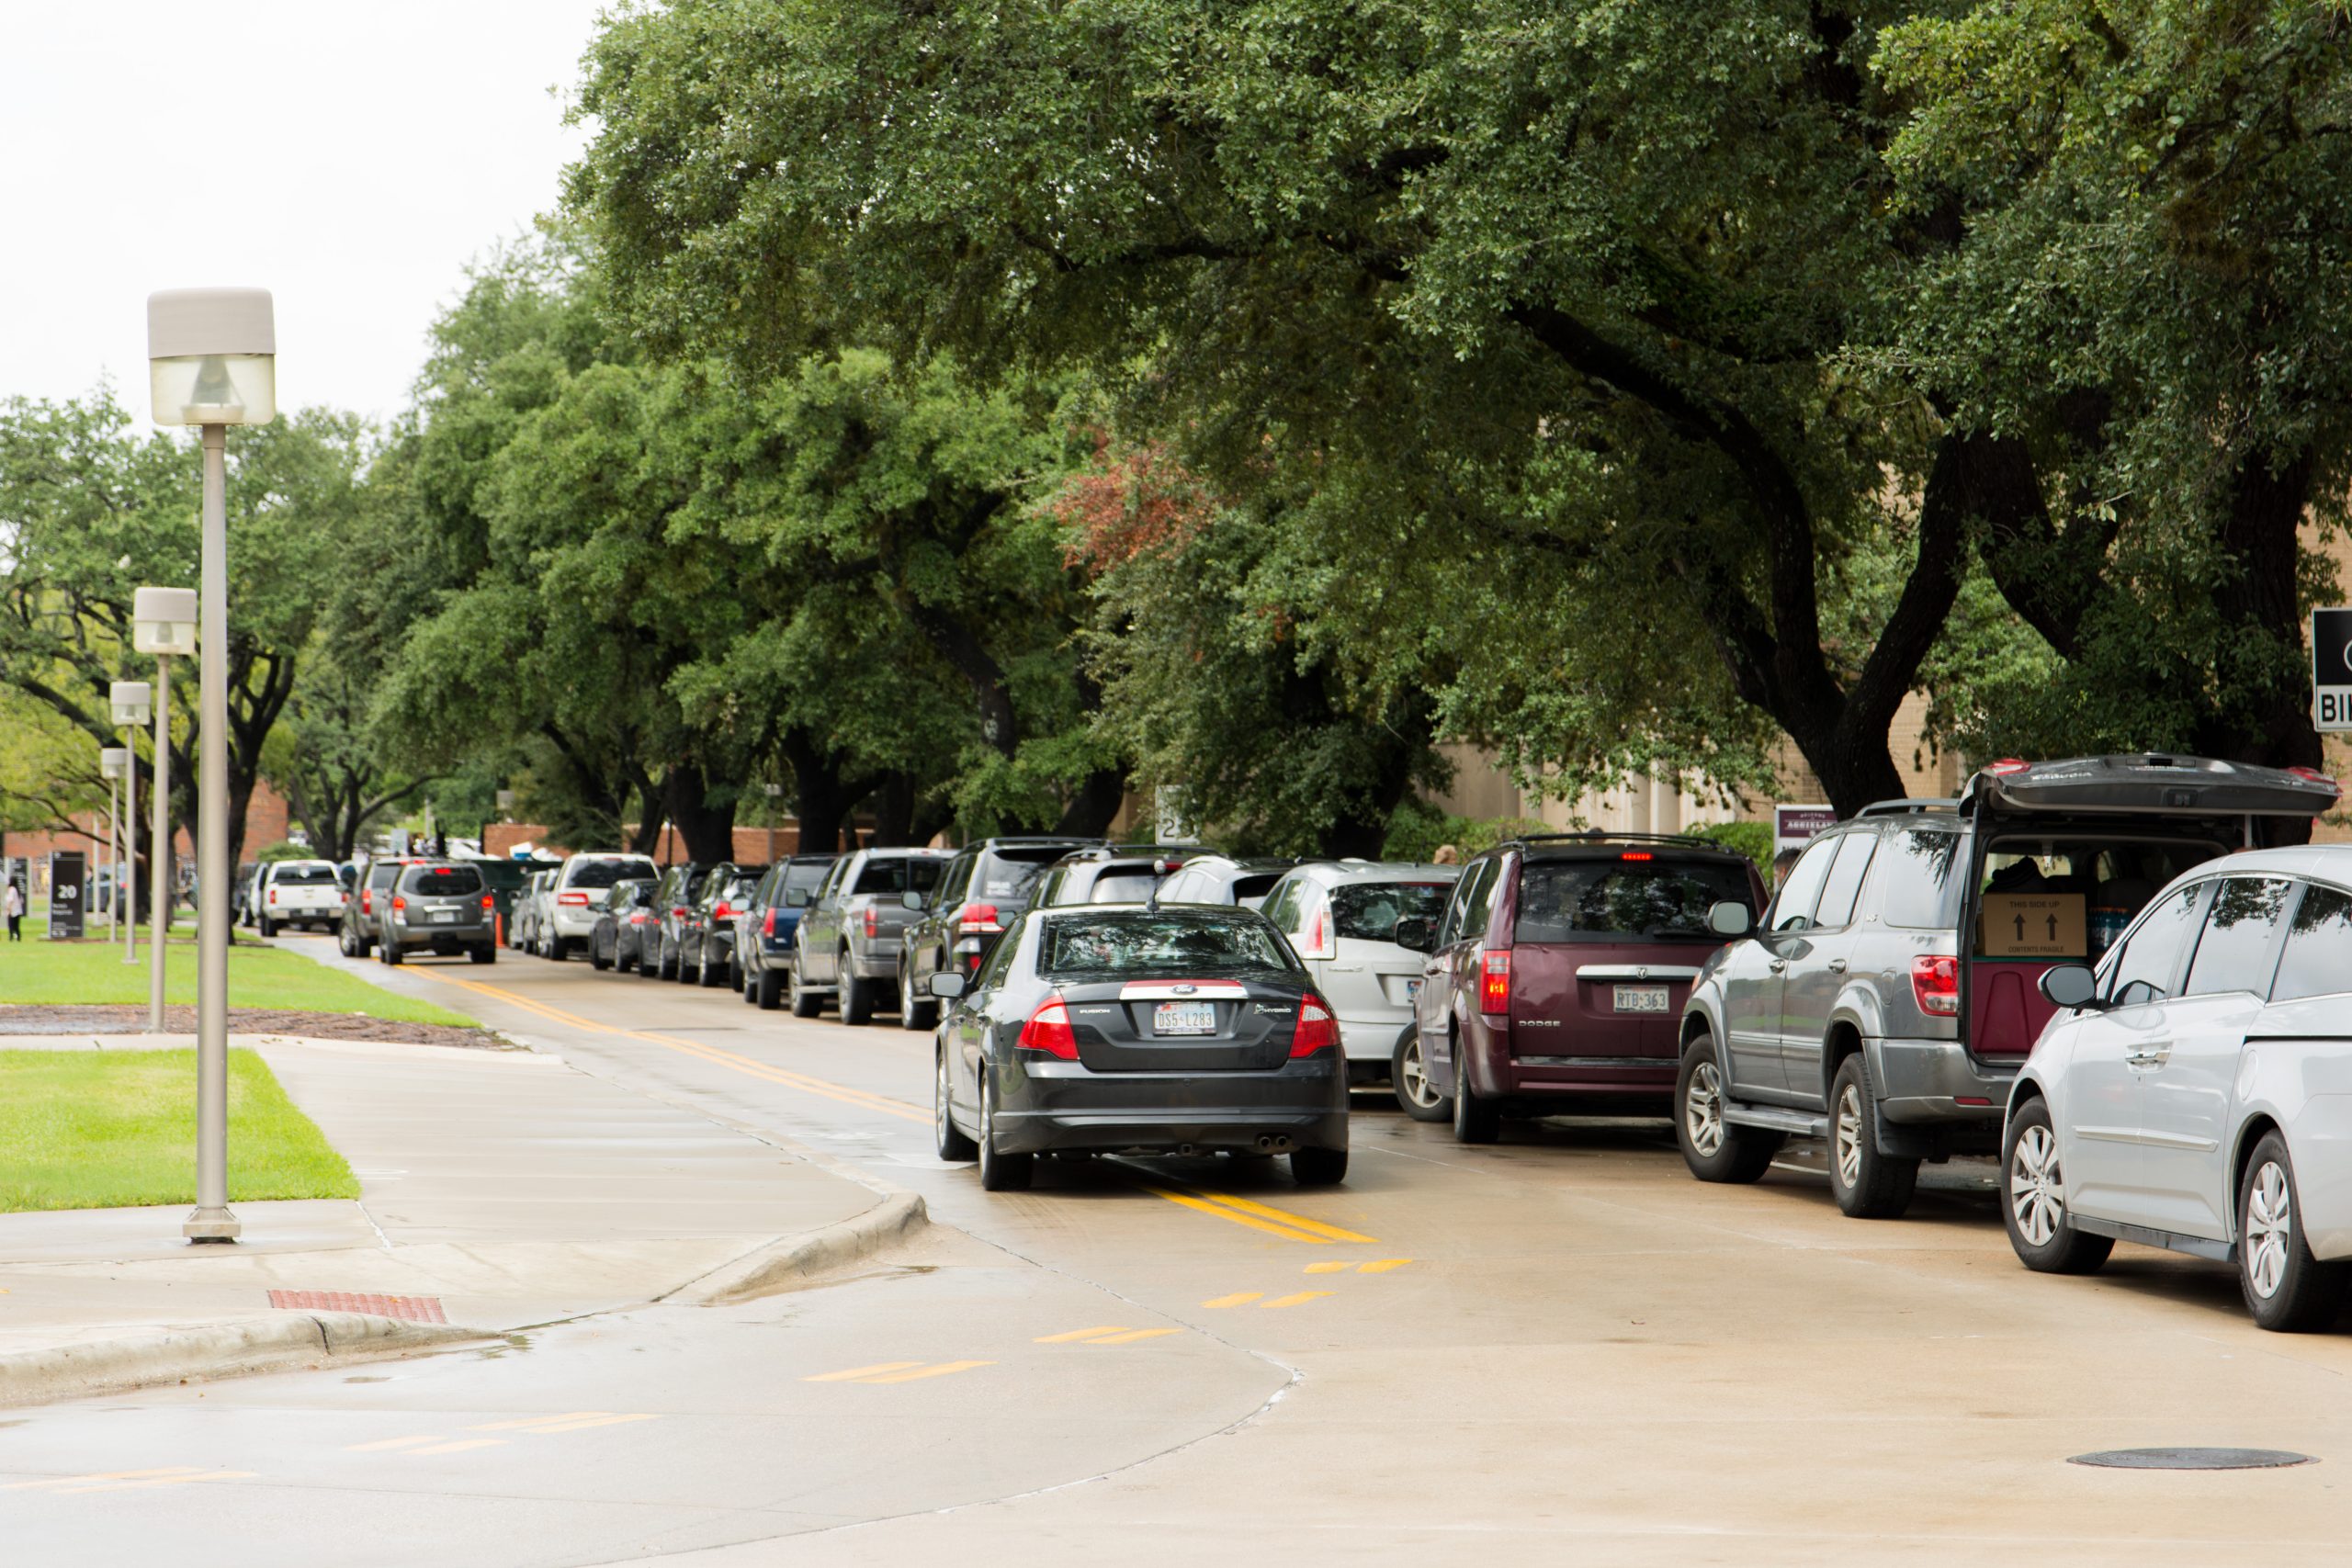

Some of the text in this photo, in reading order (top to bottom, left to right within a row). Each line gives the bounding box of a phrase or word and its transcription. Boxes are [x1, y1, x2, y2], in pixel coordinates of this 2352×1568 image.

[58, 885, 77, 899] 20
[2009, 900, 2060, 908] THIS SIDE UP
[2040, 945, 2064, 953] FRAGILE
